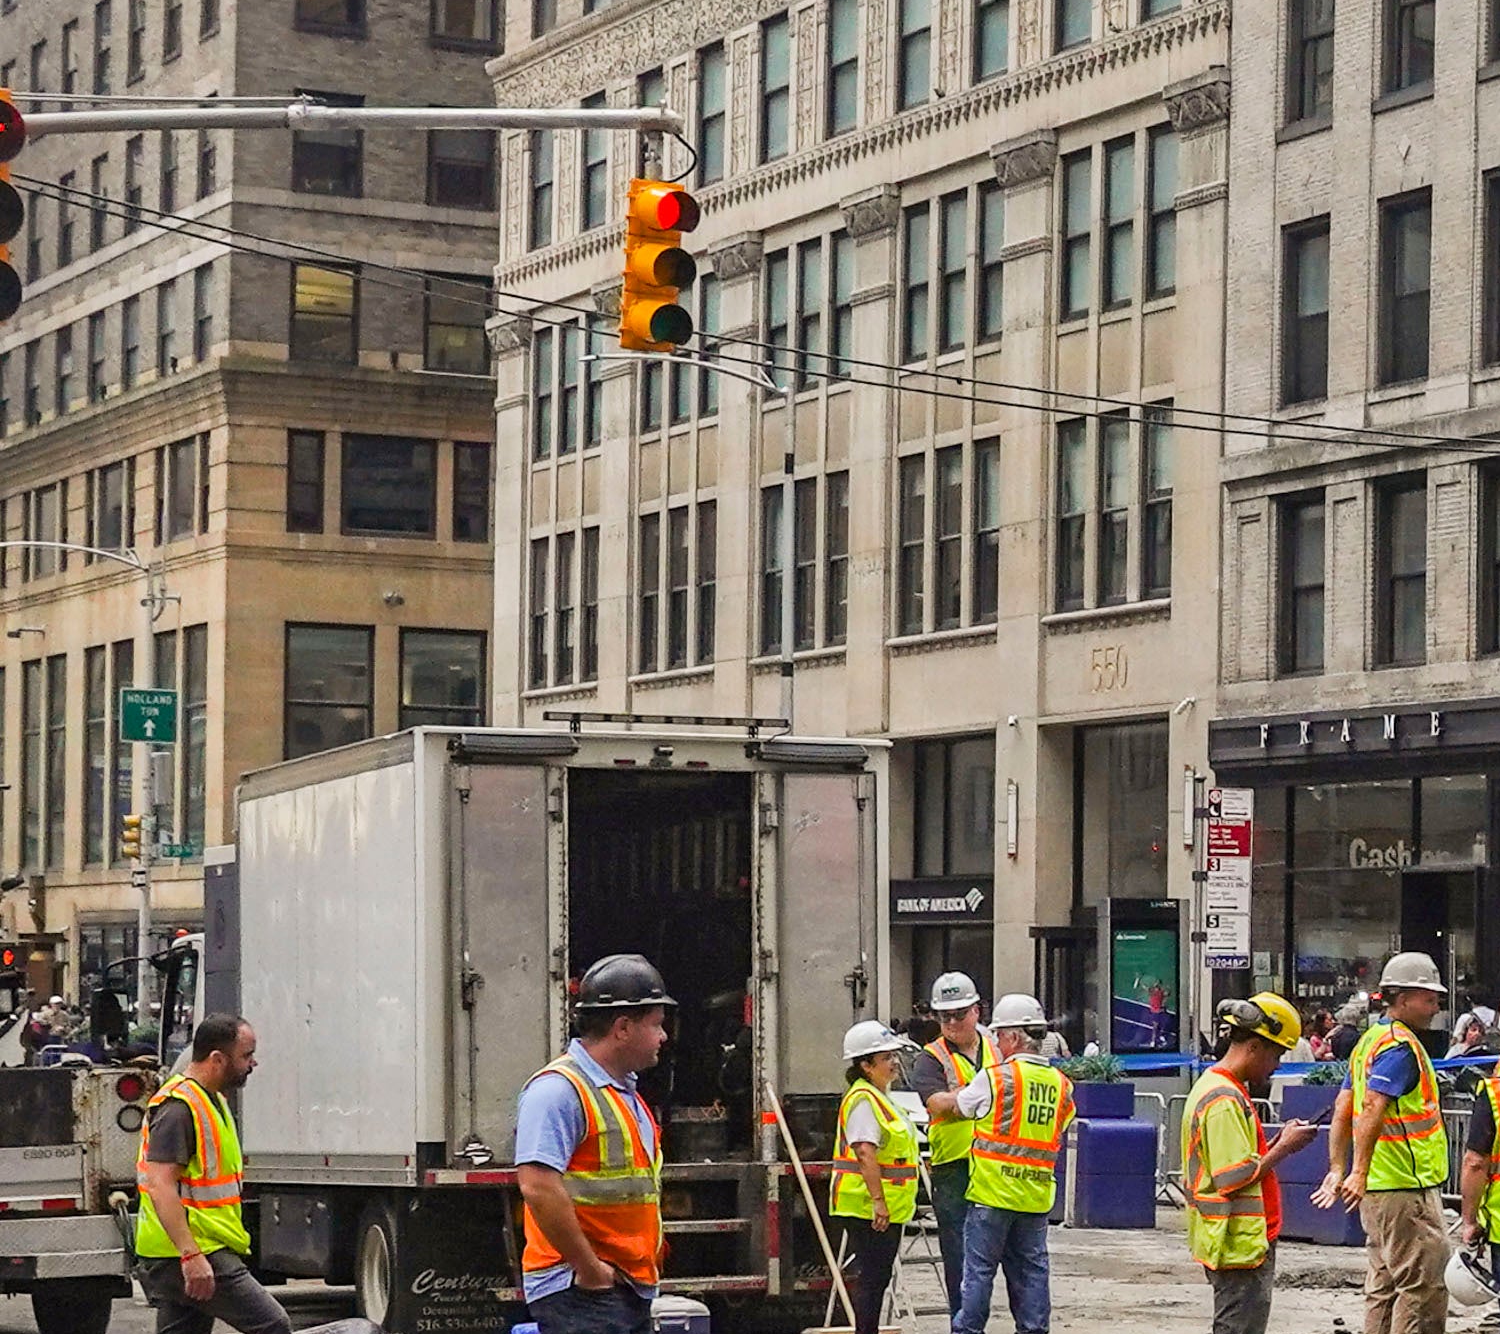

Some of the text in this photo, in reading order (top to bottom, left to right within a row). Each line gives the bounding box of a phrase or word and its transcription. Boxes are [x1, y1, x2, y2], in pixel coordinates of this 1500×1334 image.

[1090, 645, 1129, 692] 550
[127, 694, 172, 705] HOLLAND
[1029, 1082, 1057, 1104] NYC
